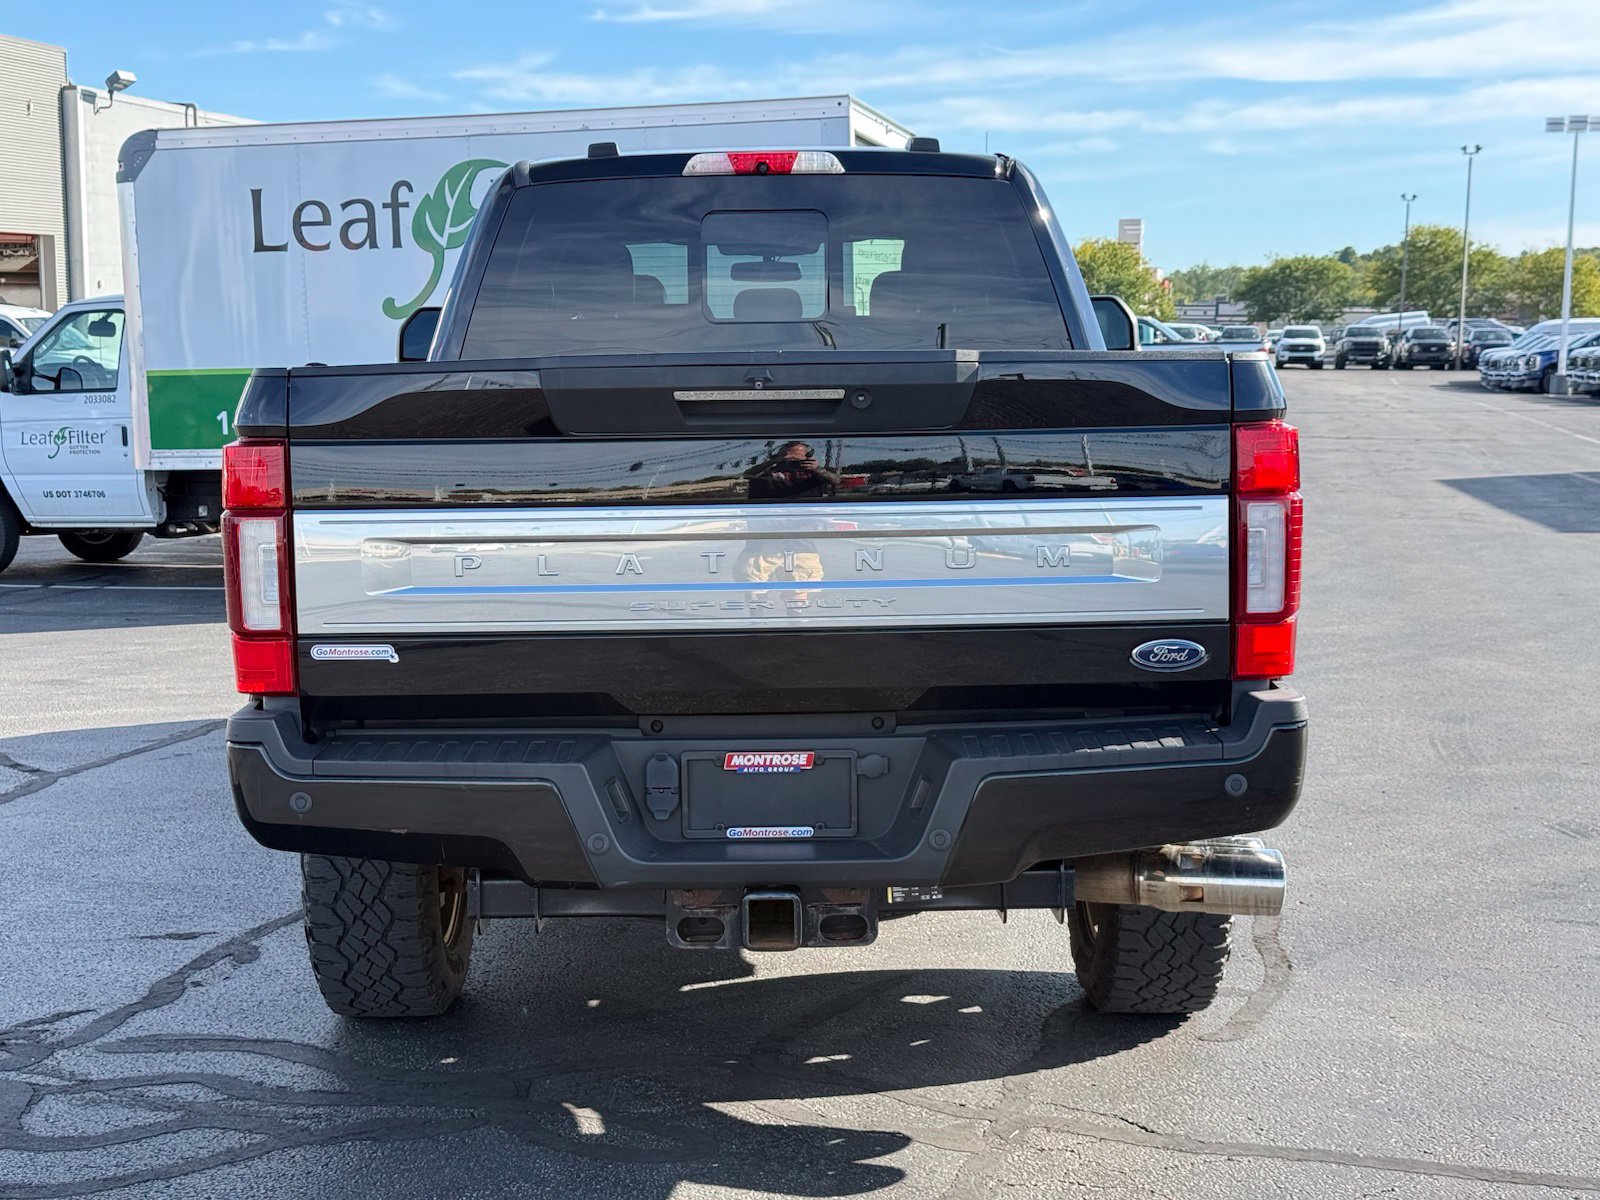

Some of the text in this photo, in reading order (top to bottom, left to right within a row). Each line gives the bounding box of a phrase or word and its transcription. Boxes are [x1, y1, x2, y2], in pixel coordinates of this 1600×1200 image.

[250, 179, 414, 253] Leaf
[84, 395, 117, 404] 2033082
[43, 490, 106, 498] US DOT 3746706
[453, 544, 1071, 578] PLATINUM
[630, 597, 897, 611] SUPER DUTY
[316, 648, 390, 656] GoMontrose.com
[1149, 645, 1189, 662] Ford
[731, 754, 808, 766] MONTROSE
[729, 828, 812, 837] GoMontrose.com
